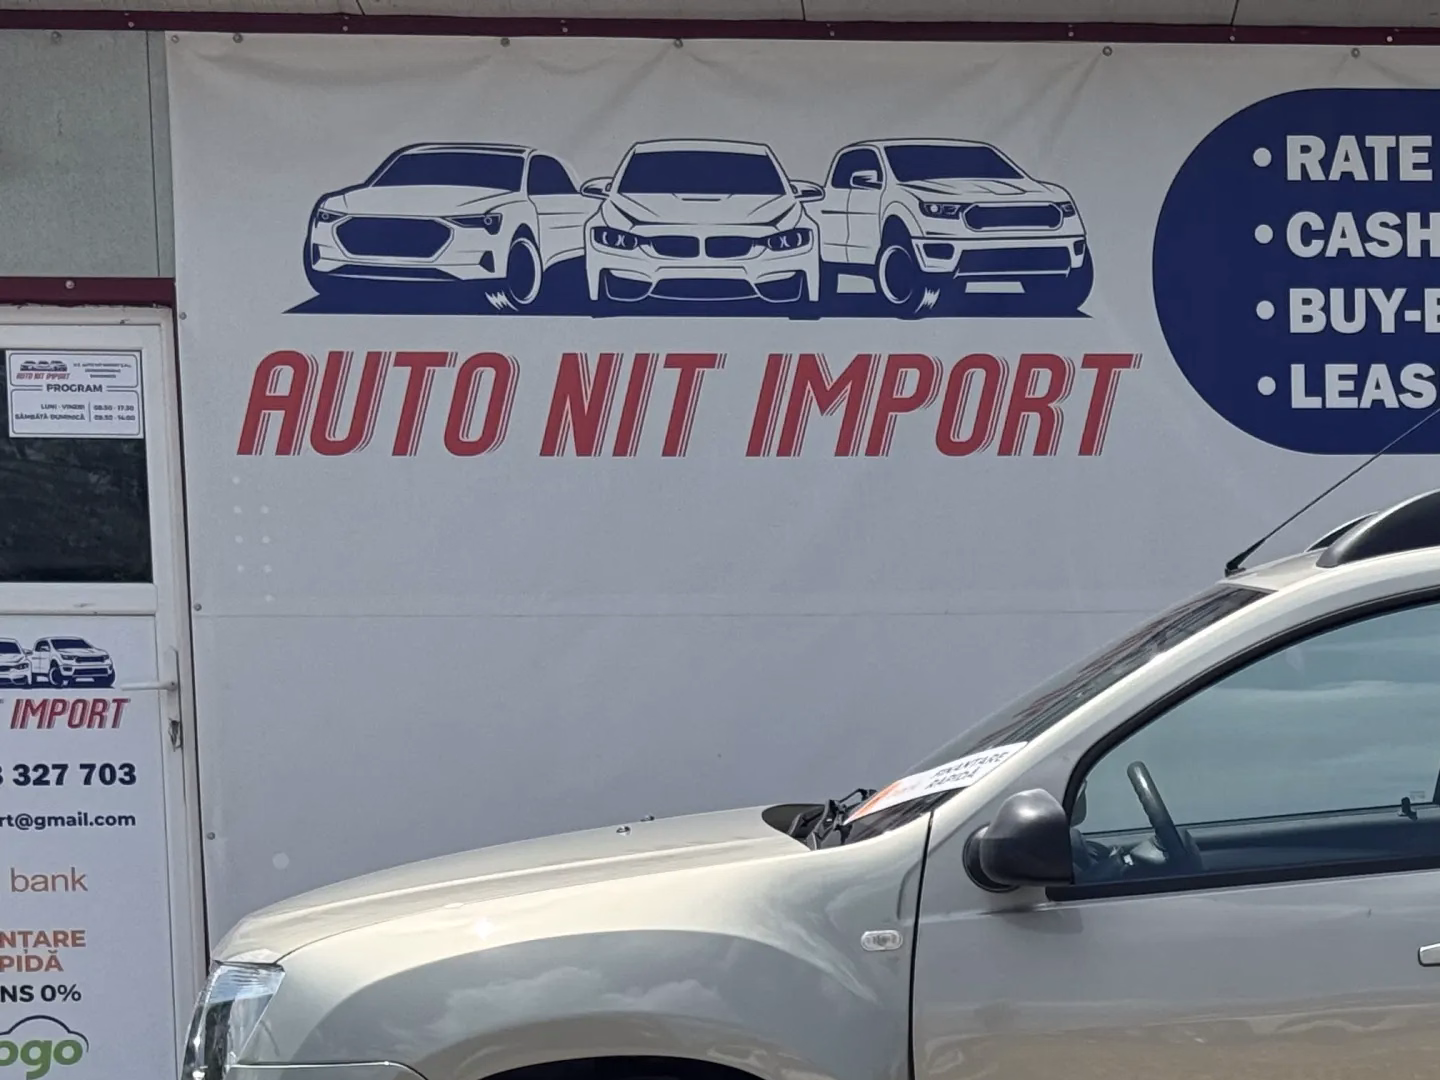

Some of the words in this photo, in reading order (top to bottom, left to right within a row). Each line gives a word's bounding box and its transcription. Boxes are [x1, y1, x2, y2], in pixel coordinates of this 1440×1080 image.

[1286, 135, 1434, 181] RATE
[46, 383, 103, 393] PROGRAM
[236, 350, 520, 457] AUTO
[539, 352, 727, 458] NIT
[746, 352, 1143, 458] IMPORT
[10, 698, 131, 730] IMPORT
[12, 763, 69, 787] 327
[79, 762, 137, 786] 703
[10, 866, 88, 893] bank
[0, 984, 35, 1003] NS
[40, 983, 82, 1003] 0%
